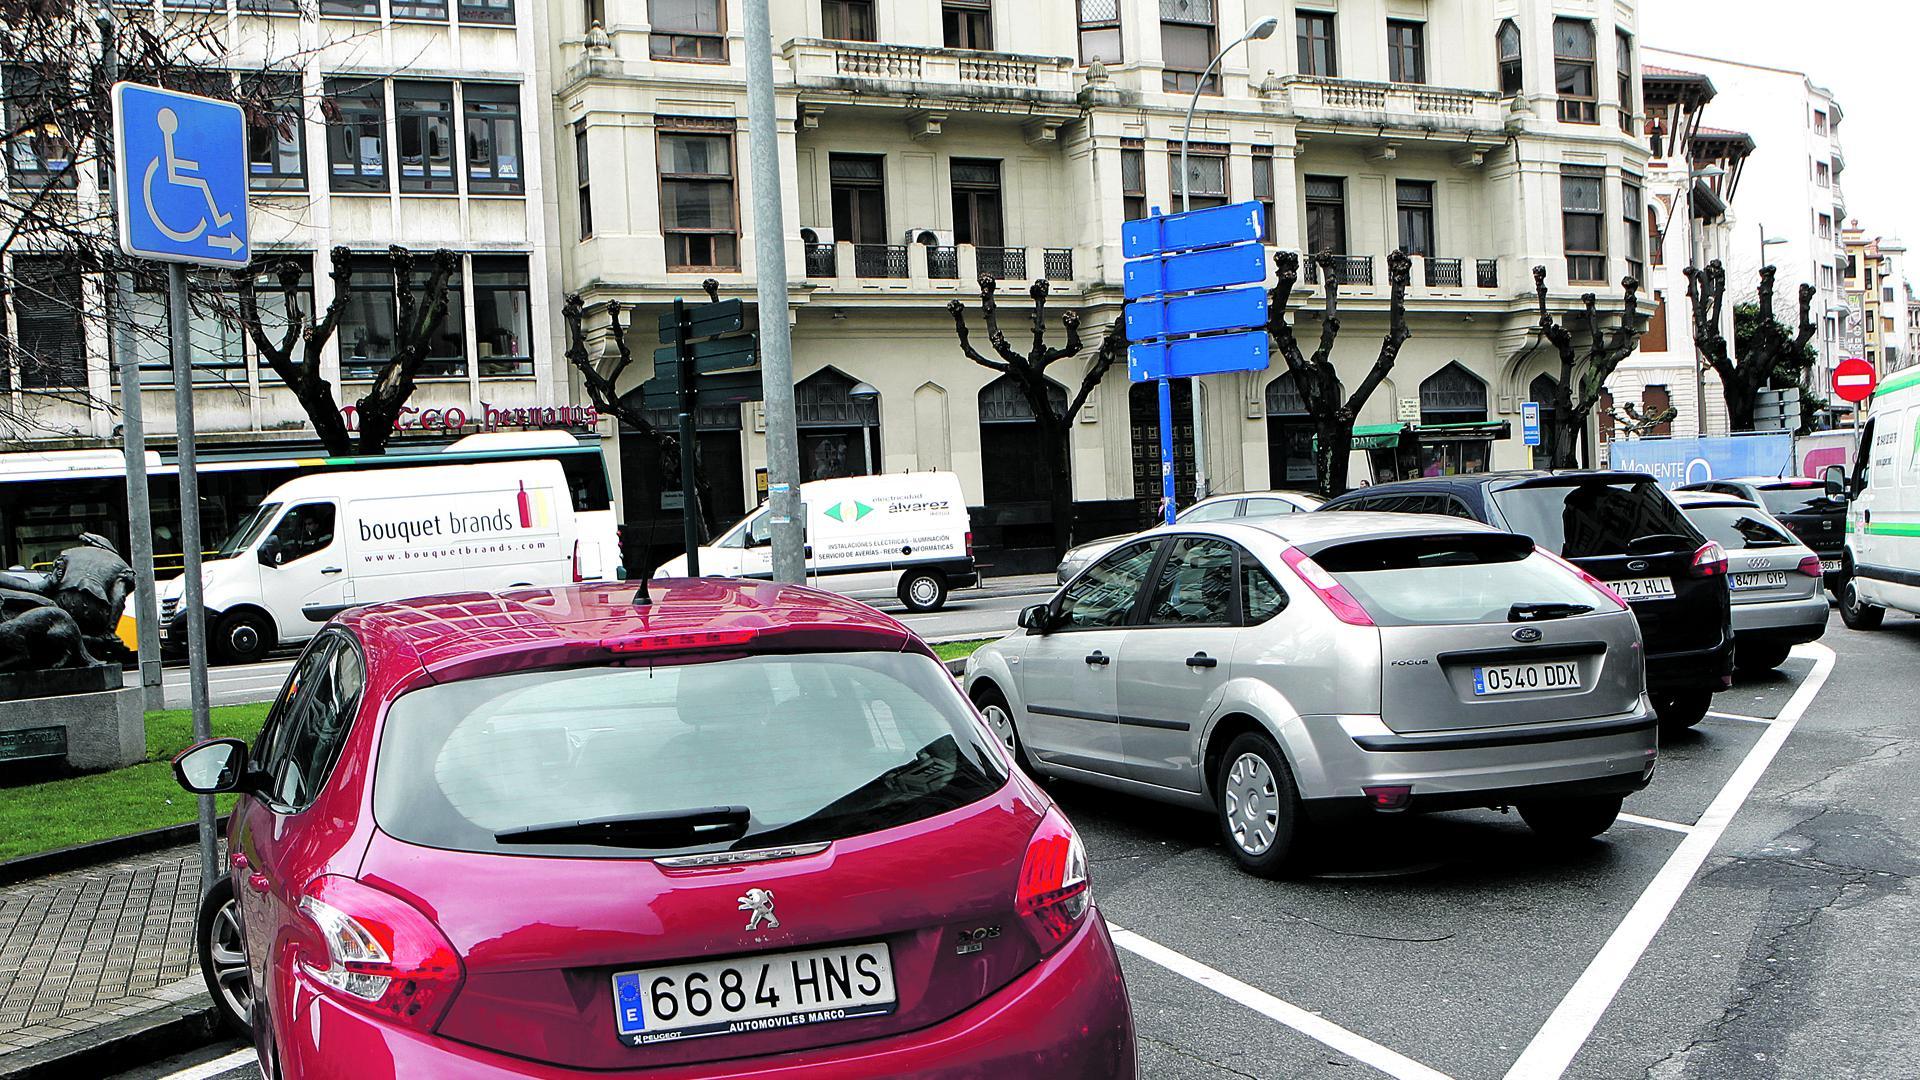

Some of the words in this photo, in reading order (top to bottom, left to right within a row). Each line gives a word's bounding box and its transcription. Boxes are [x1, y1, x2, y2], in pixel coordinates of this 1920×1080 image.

[889, 501, 949, 513] álvarez
[359, 515, 442, 543] bouquet
[449, 508, 513, 534] brands
[364, 541, 546, 562] www.bouquetbrands.com
[818, 551, 845, 560] SERVICIO
[883, 547, 902, 555] REDES
[828, 541, 873, 550] INSTALACIONES
[1606, 581, 1640, 595] 712
[1643, 579, 1671, 593] HLL
[1736, 573, 1759, 587] 8477
[1767, 571, 1784, 585] GYP
[1391, 659, 1429, 667] FOCUS
[1487, 666, 1538, 690] 0540
[1544, 664, 1578, 687] DDX
[626, 1008, 638, 1021] E
[650, 963, 780, 1021] 6684
[791, 953, 881, 1005] HNS
[642, 1031, 682, 1041] PEUGEOT
[729, 1014, 806, 1032] AUTOMOVILES
[808, 1009, 846, 1023] MARCO
